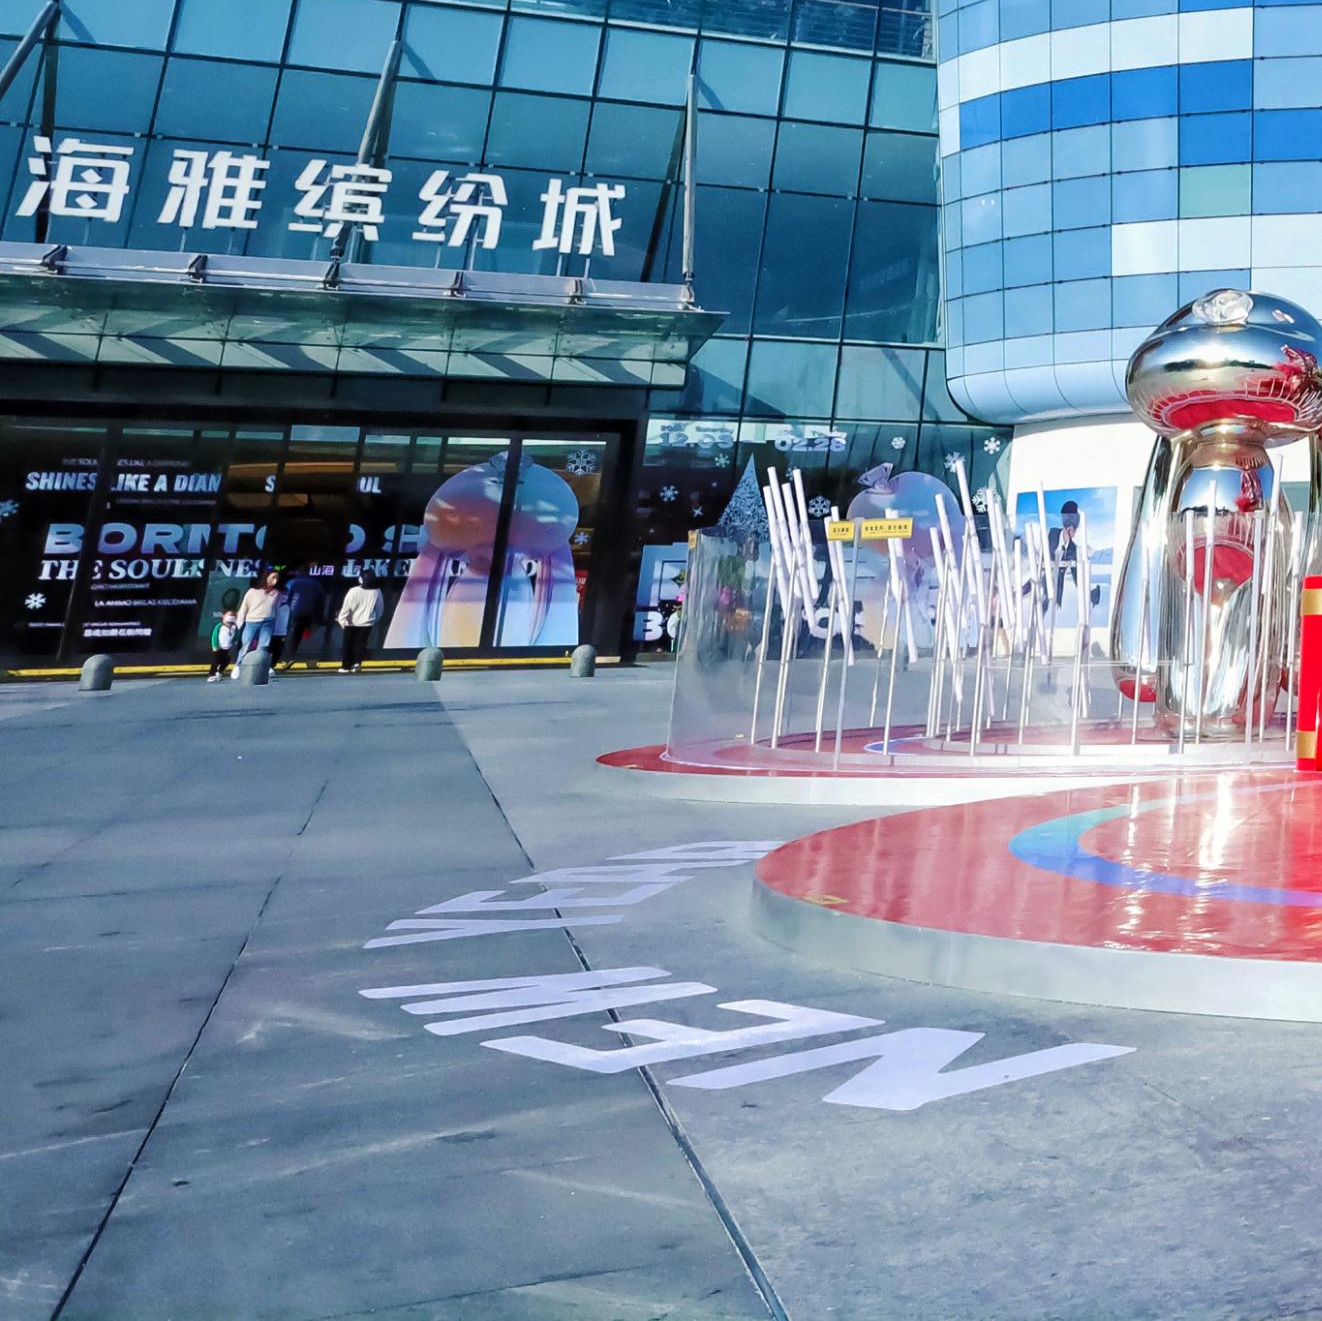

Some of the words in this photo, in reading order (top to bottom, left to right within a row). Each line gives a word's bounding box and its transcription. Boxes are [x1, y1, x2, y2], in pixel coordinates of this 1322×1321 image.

[16, 135, 626, 257] 海雅缤纷城
[358, 965, 1138, 1111] NEW
